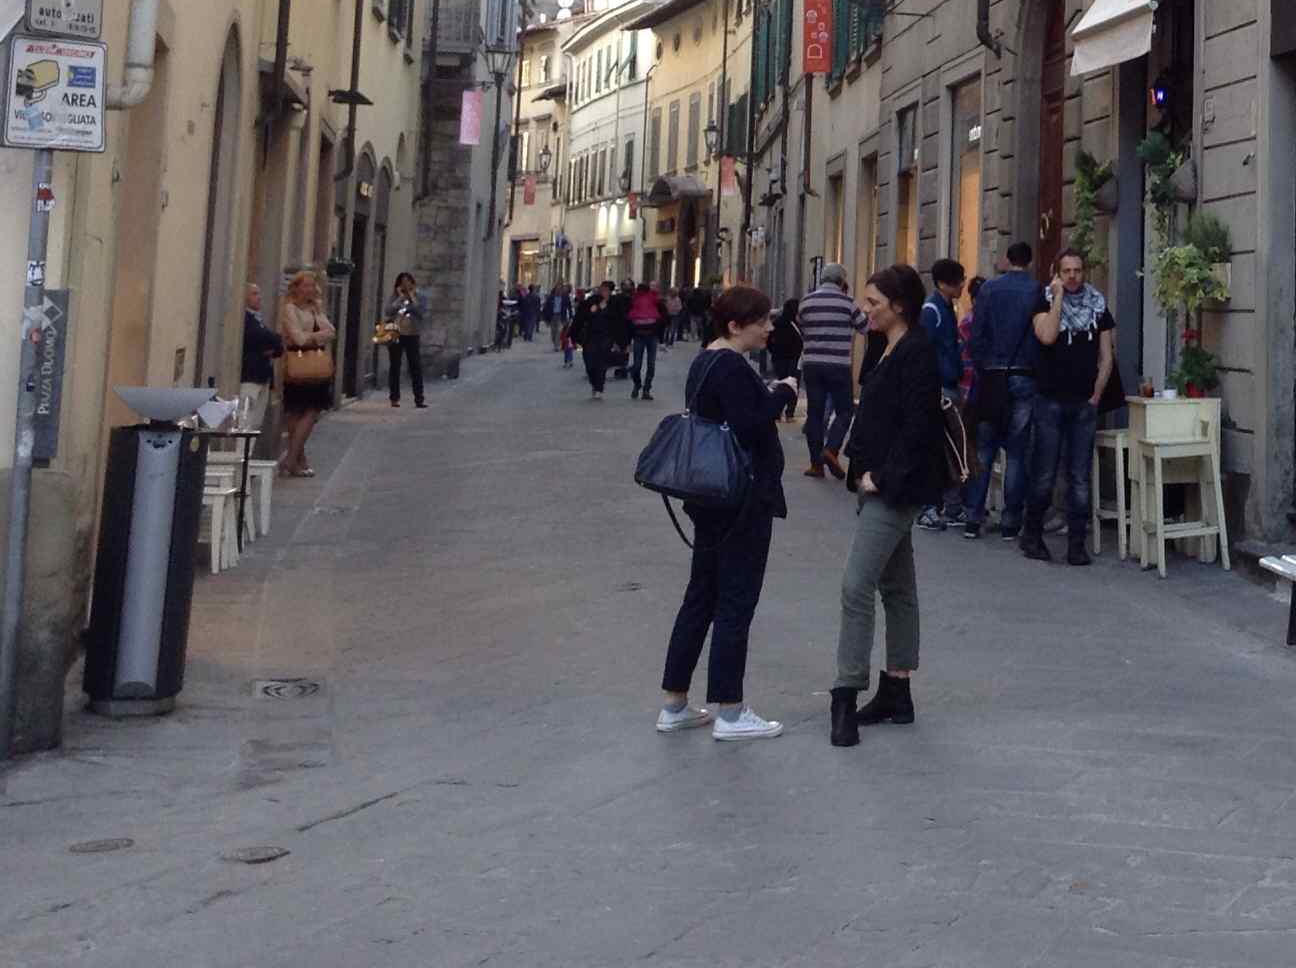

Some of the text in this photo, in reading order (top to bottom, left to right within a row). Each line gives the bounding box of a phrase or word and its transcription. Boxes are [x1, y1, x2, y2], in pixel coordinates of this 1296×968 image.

[62, 92, 97, 108] AREA
[37, 329, 57, 414] PIAZZA DUOMO
